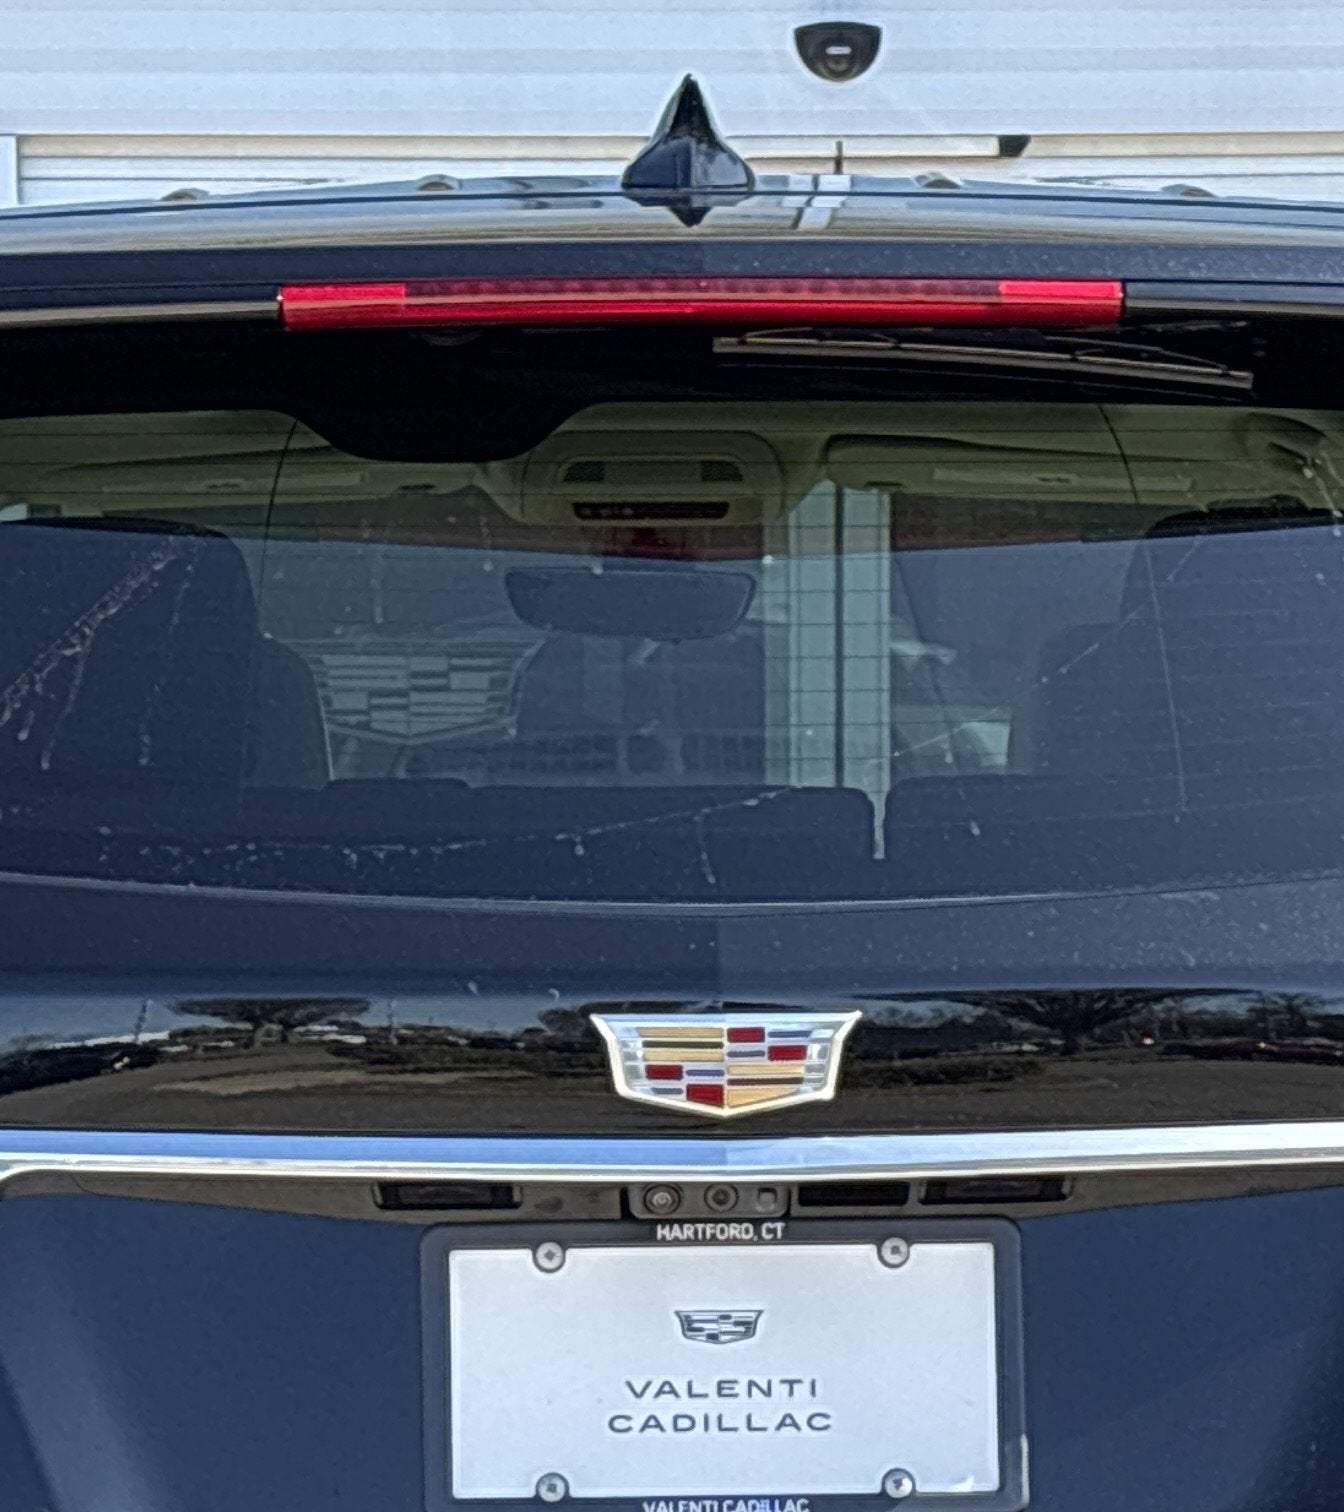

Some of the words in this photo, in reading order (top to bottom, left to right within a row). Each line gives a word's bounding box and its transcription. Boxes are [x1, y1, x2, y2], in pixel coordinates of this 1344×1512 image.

[657, 1222, 758, 1241] HARTFORD,
[761, 1221, 786, 1240] CT
[624, 1378, 817, 1400] VALENTI
[607, 1412, 833, 1434] CADILLAC
